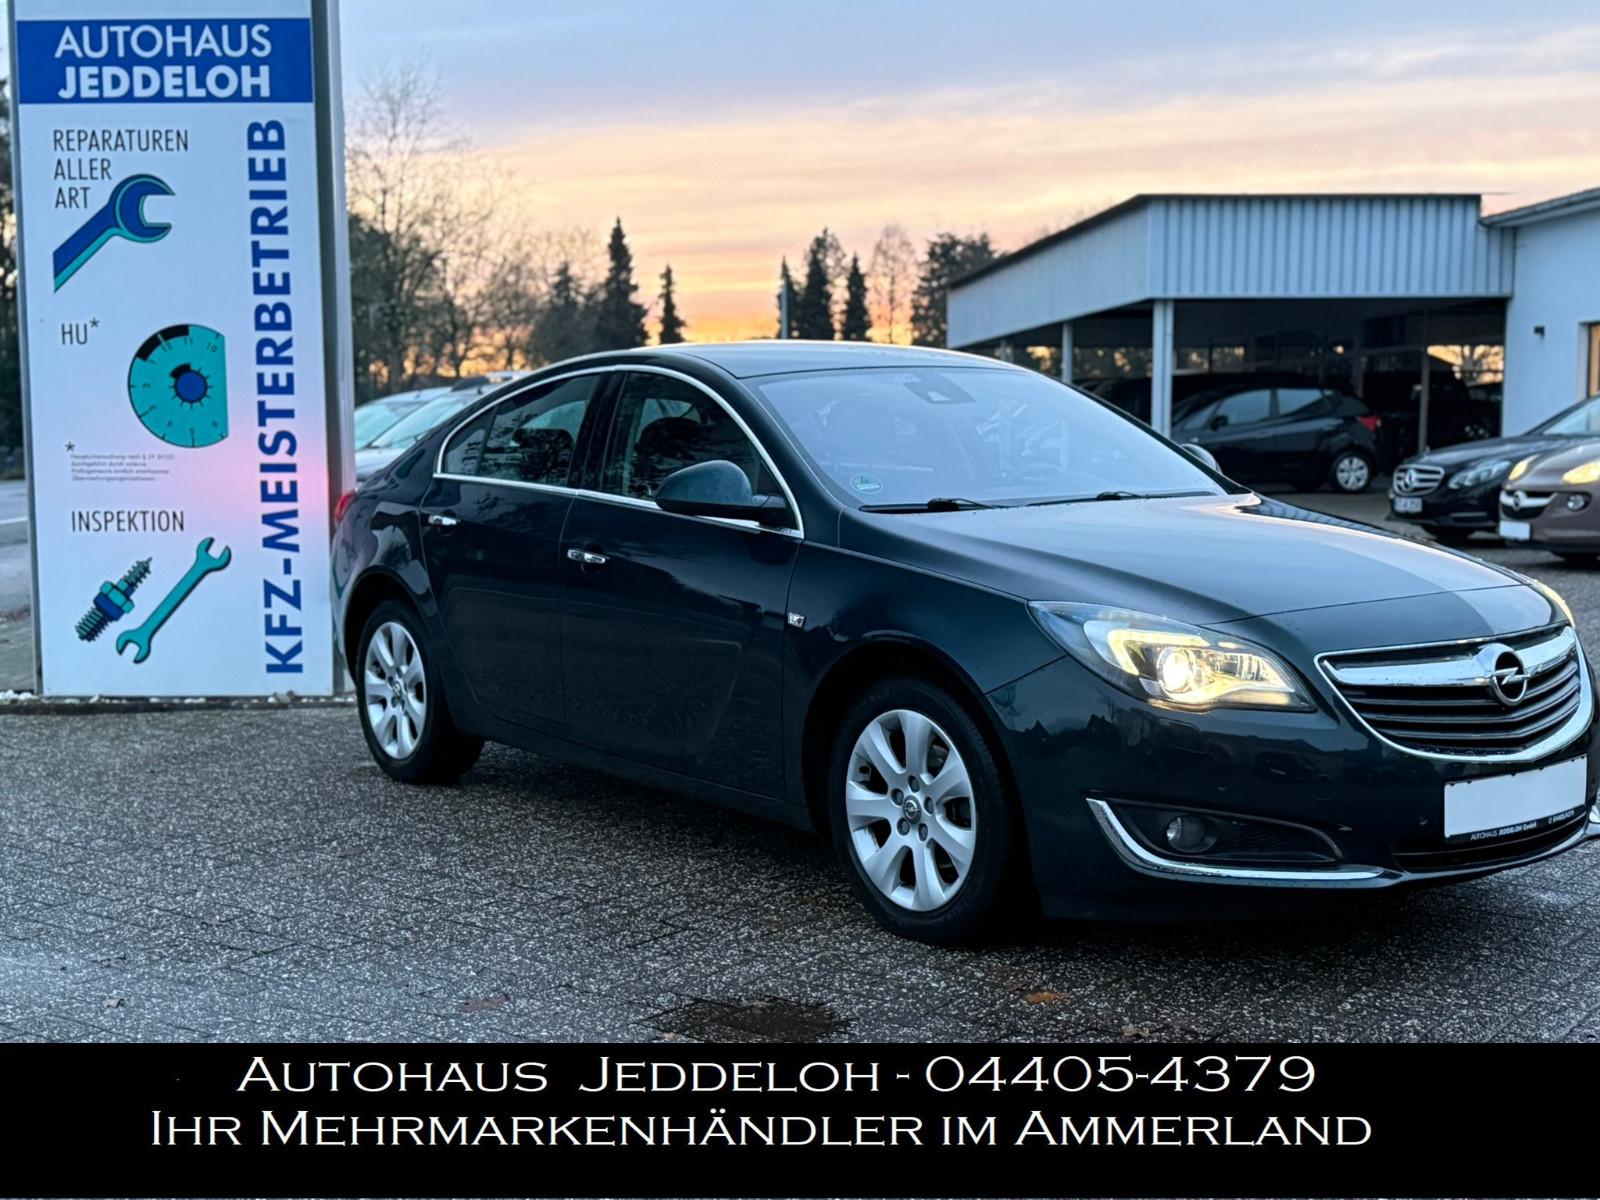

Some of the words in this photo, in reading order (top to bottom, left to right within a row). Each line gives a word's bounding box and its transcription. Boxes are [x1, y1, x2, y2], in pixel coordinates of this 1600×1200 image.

[54, 24, 272, 59] AUTOHAUS
[58, 65, 271, 99] JEDDELOH
[53, 129, 189, 152] REPARATUREN
[54, 158, 112, 180] ALLER
[54, 187, 90, 209] ART
[246, 119, 304, 674] KFZ-MEISTERBETRIEB
[71, 510, 185, 532] INSPEKTION
